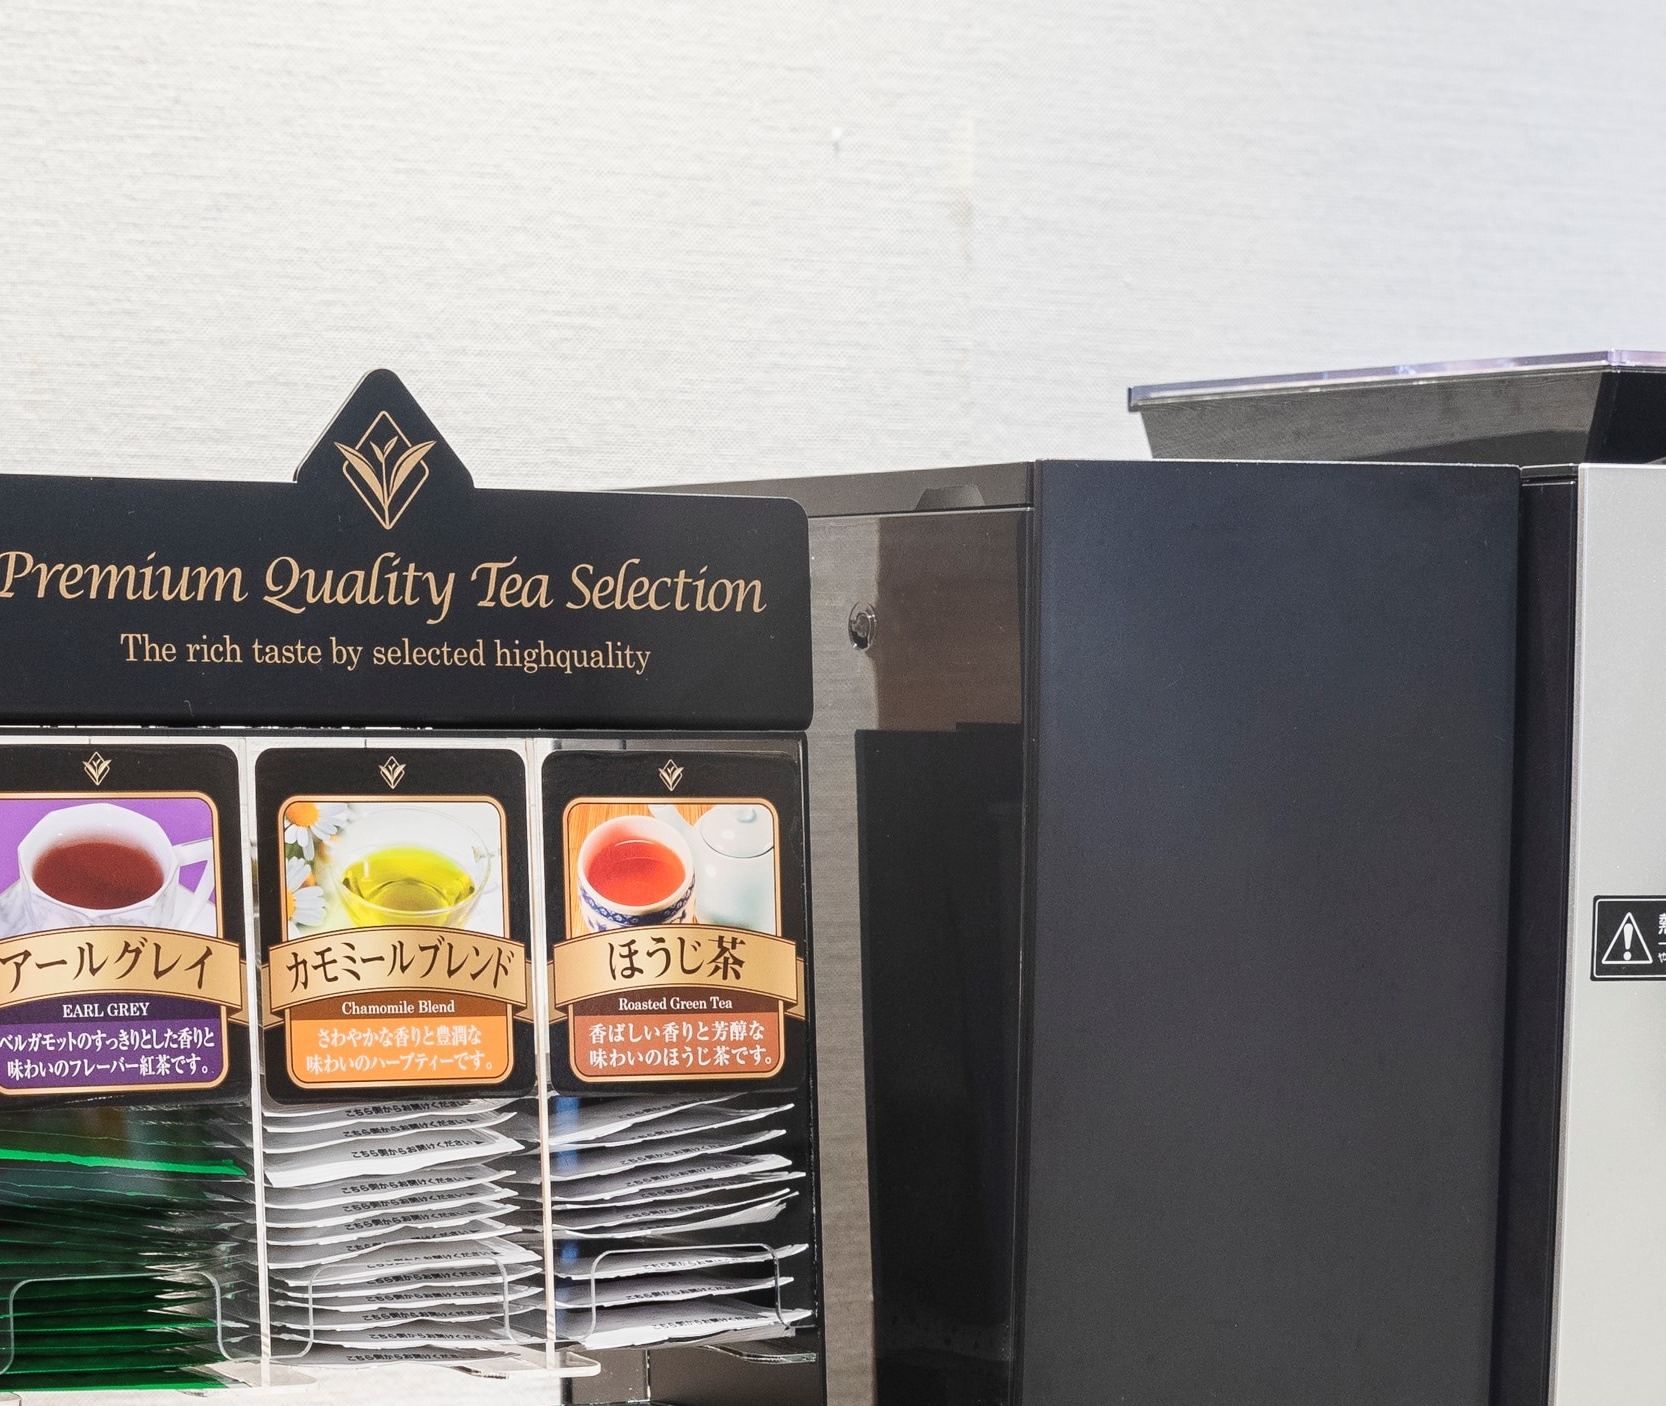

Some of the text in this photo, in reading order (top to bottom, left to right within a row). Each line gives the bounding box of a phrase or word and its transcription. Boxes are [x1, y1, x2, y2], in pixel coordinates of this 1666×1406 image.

[263, 551, 455, 625] Quality
[470, 556, 554, 609] Tea
[566, 558, 767, 613] Selection
[120, 633, 651, 675] The rich taste by selected highquality
[286, 934, 515, 994] カモミールブレンド
[608, 935, 747, 981] ほうじ茶
[63, 1002, 150, 1018] EARL GREY
[341, 1000, 455, 1016] Chamomile Blend
[618, 996, 733, 1011] Roasted Green Tea
[317, 1024, 482, 1049] さわやかな香りと豊潤な
[589, 1020, 765, 1044] 香ばしい香りと芳醇な
[7, 1054, 210, 1081] 味わいのフレーバー紅茶です。
[307, 1052, 493, 1074] 味わいのハーブティーです。
[589, 1046, 773, 1069] 味わいのほうじ茶です。
